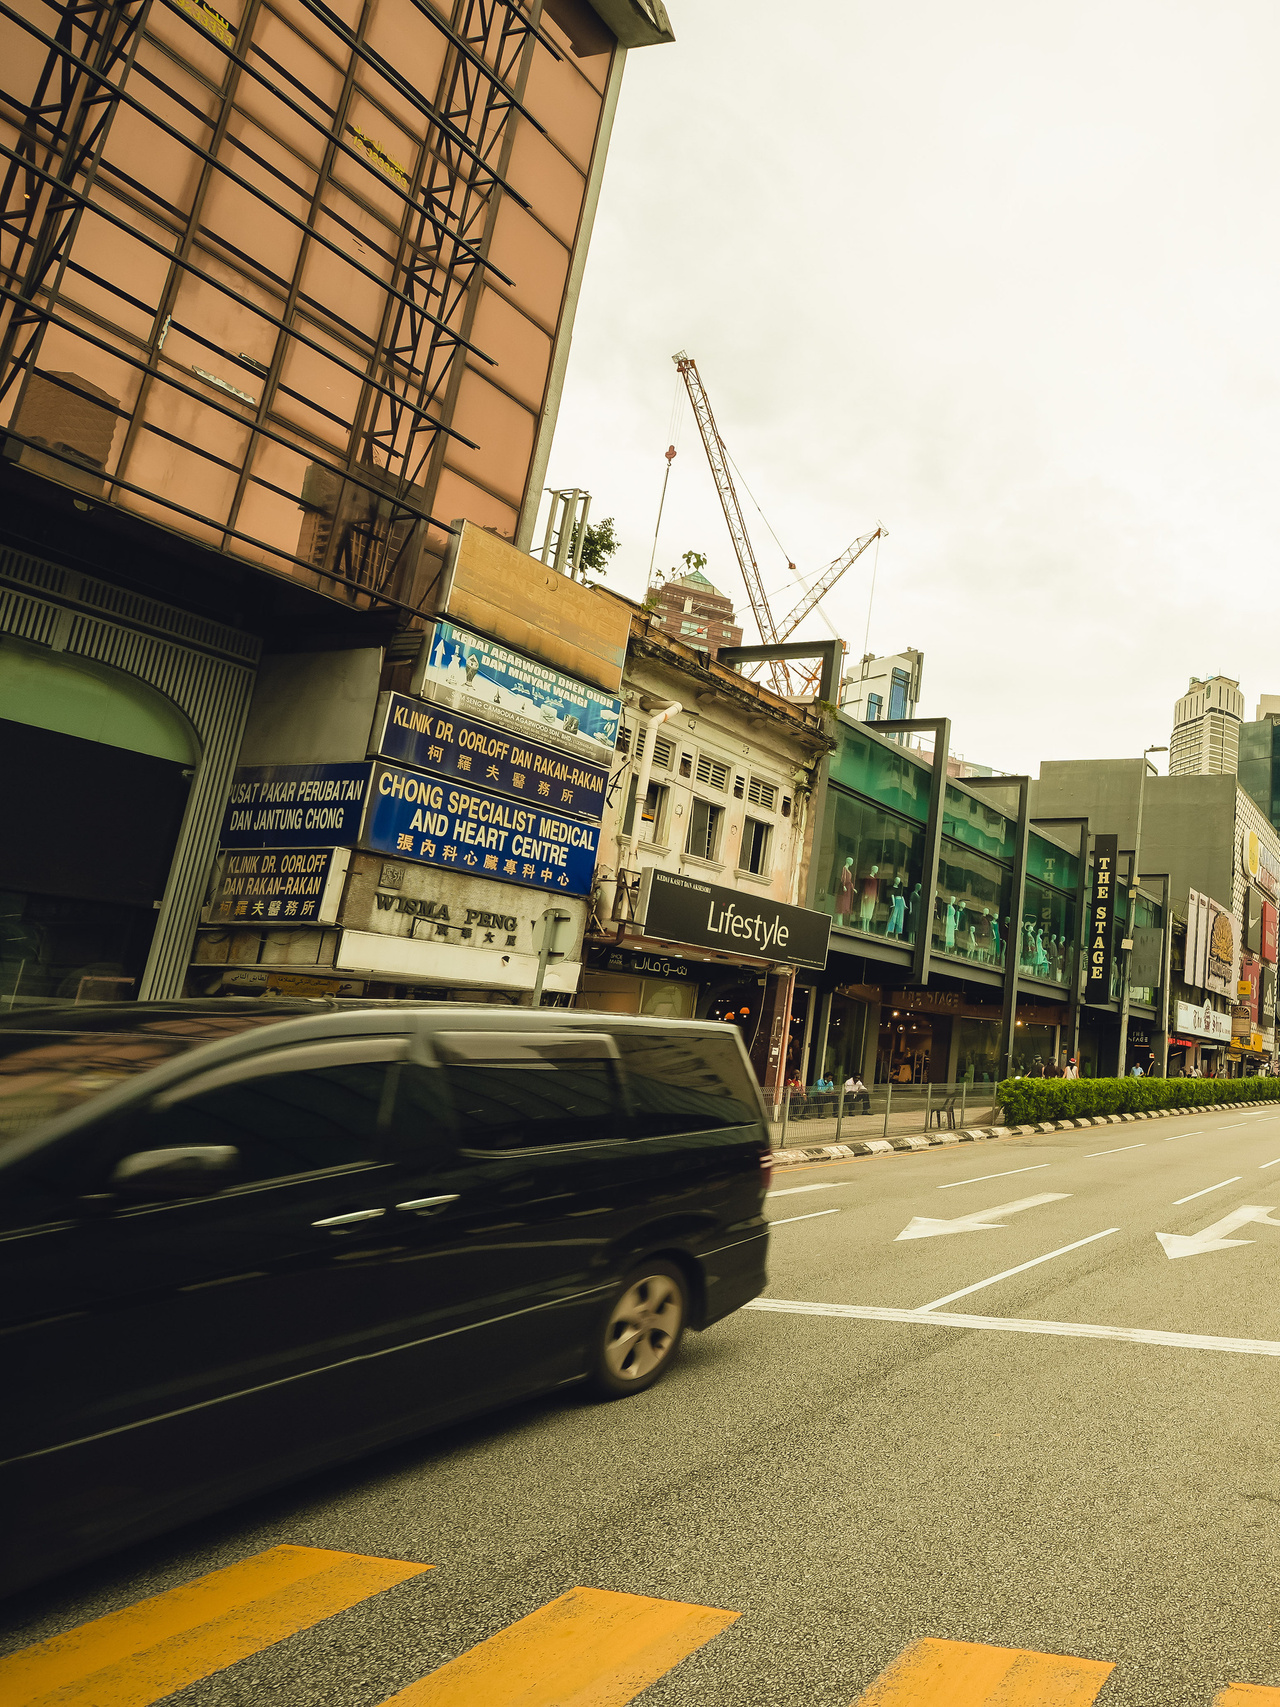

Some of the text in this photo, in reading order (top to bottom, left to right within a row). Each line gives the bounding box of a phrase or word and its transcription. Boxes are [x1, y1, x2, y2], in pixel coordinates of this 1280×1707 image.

[452, 630, 490, 652] KEDAI
[491, 646, 557, 682] AGARWOOD
[558, 673, 585, 695] DHEN
[586, 685, 614, 709] OUDH
[481, 655, 506, 673] DAN
[508, 665, 551, 694] MINYAK
[552, 684, 588, 708] WANGI
[466, 696, 483, 708] SENG
[483, 701, 516, 720] CAMBODIA
[516, 715, 550, 733] AGARWOOD
[393, 705, 432, 736] KLINIK
[435, 720, 454, 743] DR.
[458, 728, 510, 760] OORLOFF
[510, 746, 533, 769] DAN
[533, 754, 604, 793] RAKAN-RAKAN
[260, 782, 297, 803] PAKAR
[297, 780, 364, 802] PERUBATAN
[427, 744, 575, 805] 柯羅夫醫務所
[230, 807, 345, 831] DAN JANTUNG CHONG
[378, 772, 595, 851] CHONG SPECIALIST MEDICAL
[410, 808, 569, 867] AND HEART CENTRE
[227, 854, 328, 874] KLINIK DR. OORLOFF
[656, 874, 670, 883] KEDAI
[670, 877, 684, 887] KASUT
[684, 881, 693, 889] DAN
[222, 876, 323, 896] DAN RAKAN-RAKAN
[219, 900, 316, 917] 柯羅夫醫務所
[374, 892, 518, 932] WISMA PENG
[706, 900, 789, 951] Lifestyle
[1091, 857, 1110, 979] THE STAGE
[926, 991, 959, 1008] STAGE
